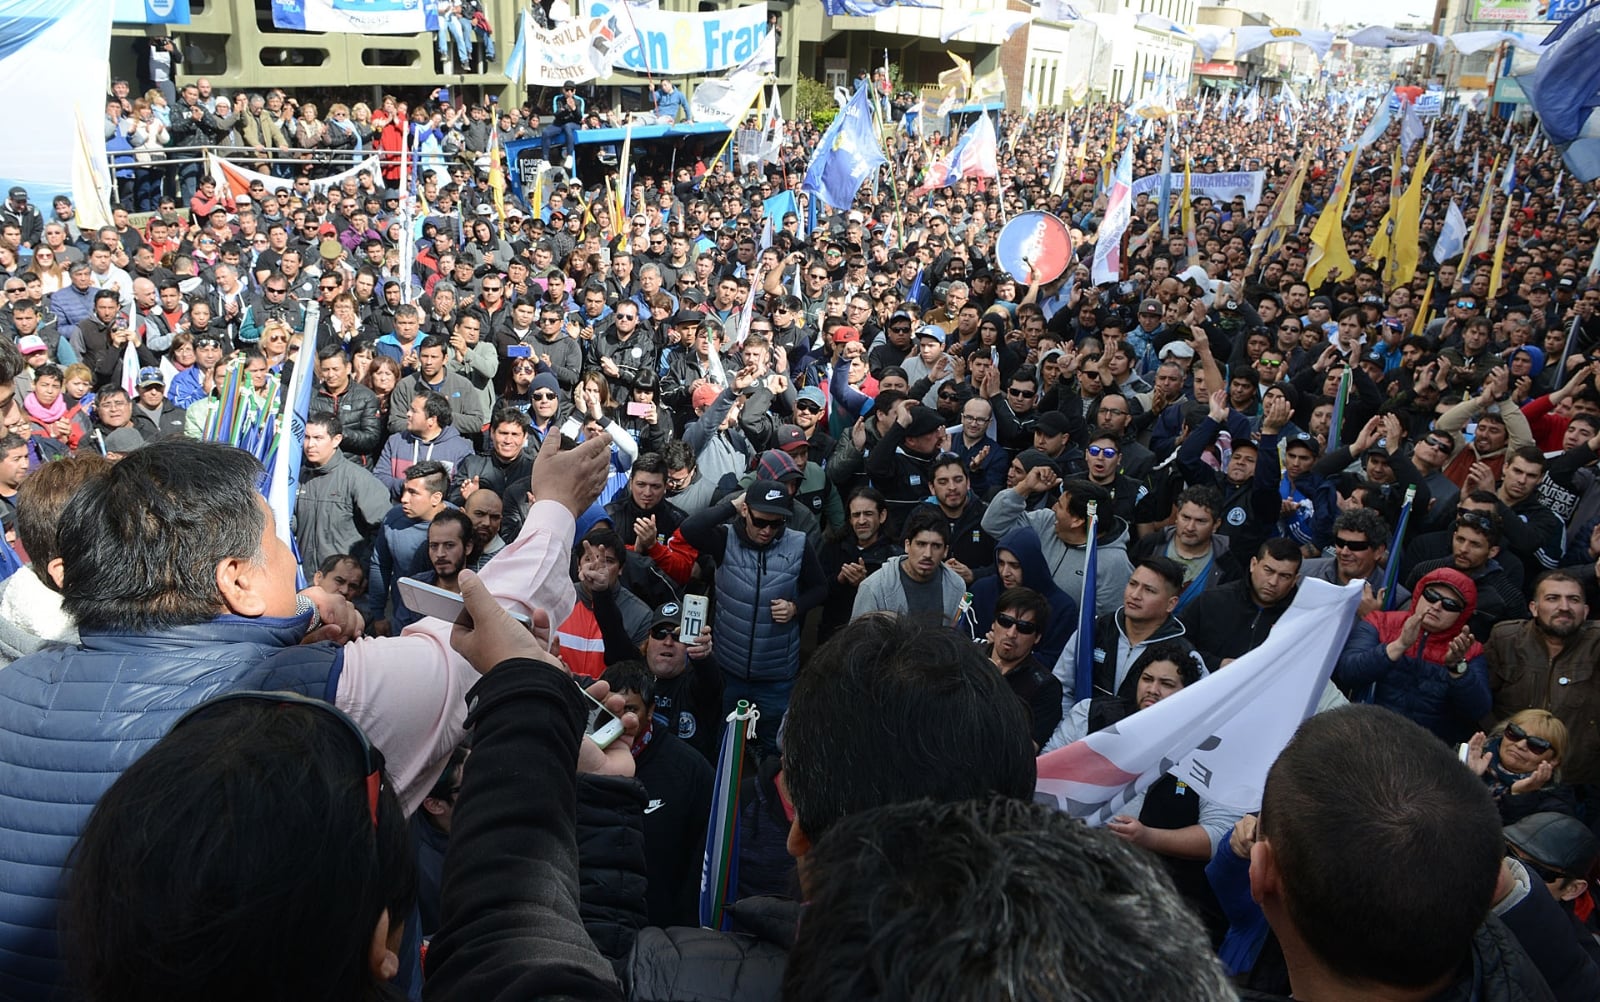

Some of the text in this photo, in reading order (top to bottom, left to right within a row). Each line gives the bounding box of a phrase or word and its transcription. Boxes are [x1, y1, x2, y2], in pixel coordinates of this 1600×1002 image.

[1175, 174, 1250, 188] TRUNFAREMOS
[291, 419, 304, 443] ONAL
[1540, 484, 1576, 505] OUTSIDE
[1551, 501, 1573, 516] BOX
[684, 617, 702, 637] 10
